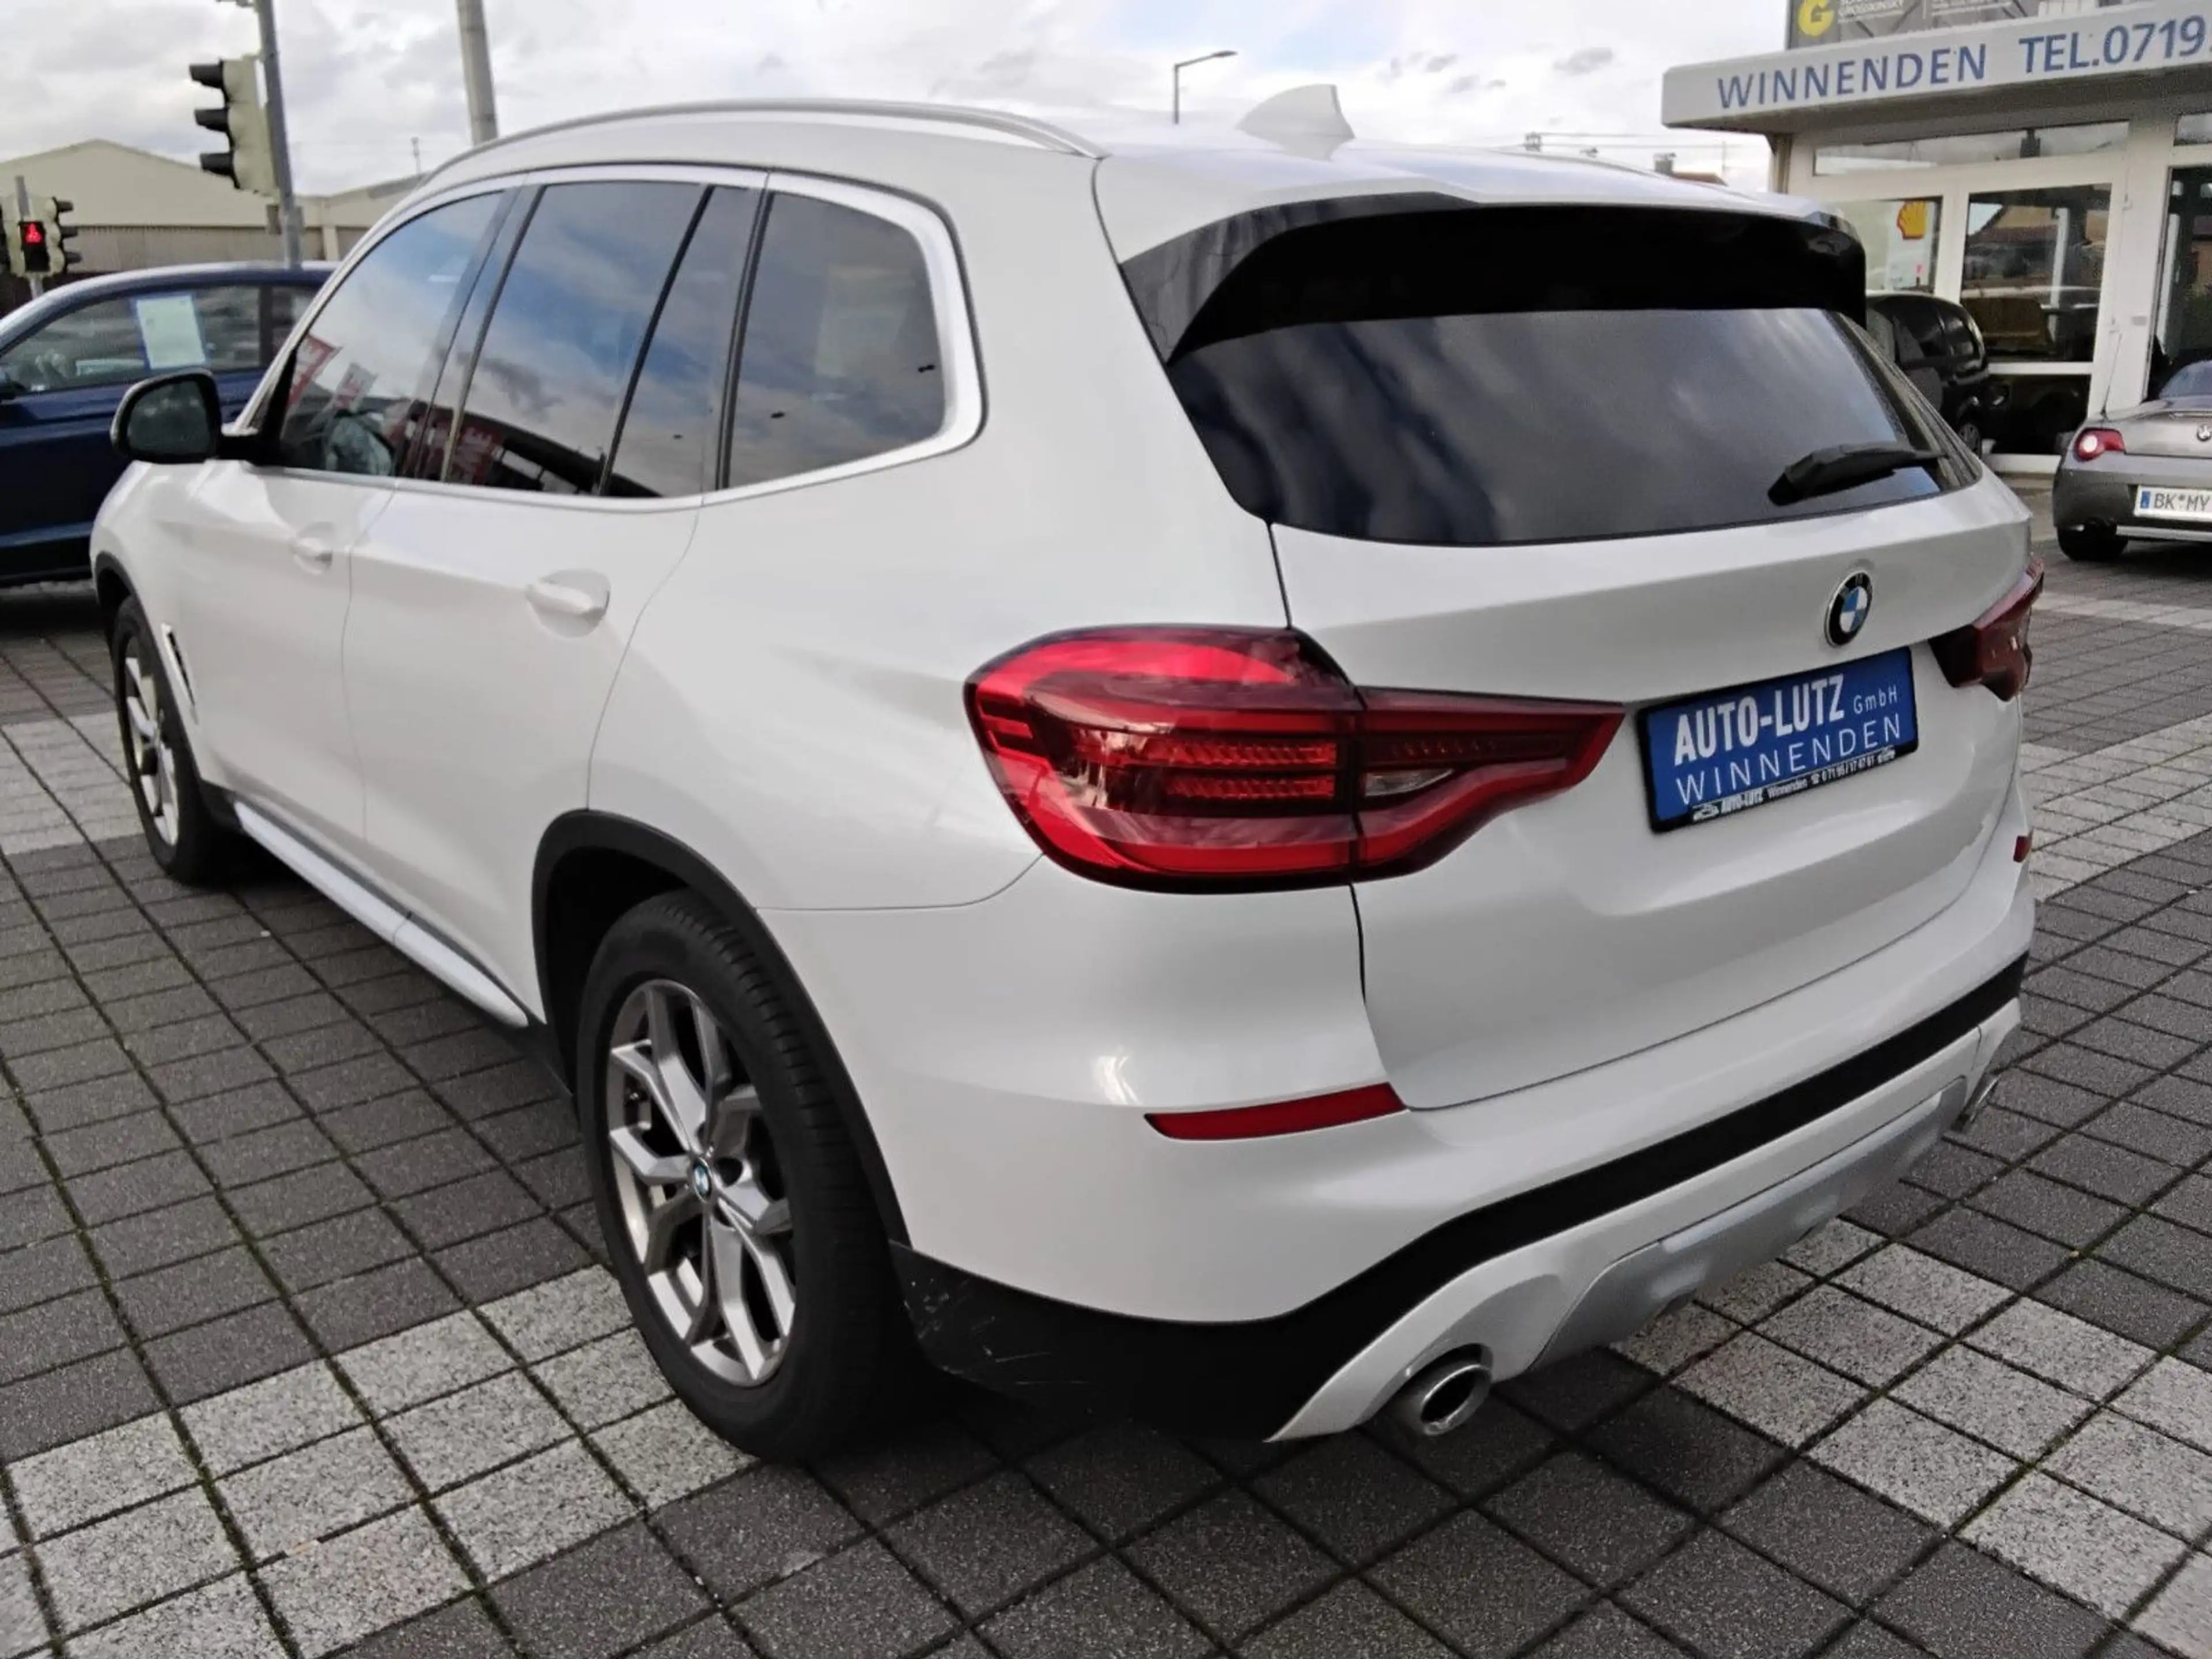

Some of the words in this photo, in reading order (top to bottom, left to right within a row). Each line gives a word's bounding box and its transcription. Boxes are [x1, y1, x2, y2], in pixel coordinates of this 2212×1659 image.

[1717, 43, 1986, 109] WINNENDEN
[2018, 14, 2212, 74] TEL.0719
[2154, 493, 2176, 509] BK
[2187, 494, 2210, 513] MY
[1674, 673, 1845, 767] AUTO-LUTZ
[1852, 684, 1897, 715] GmbH
[1675, 713, 1900, 805] WINNENDEN
